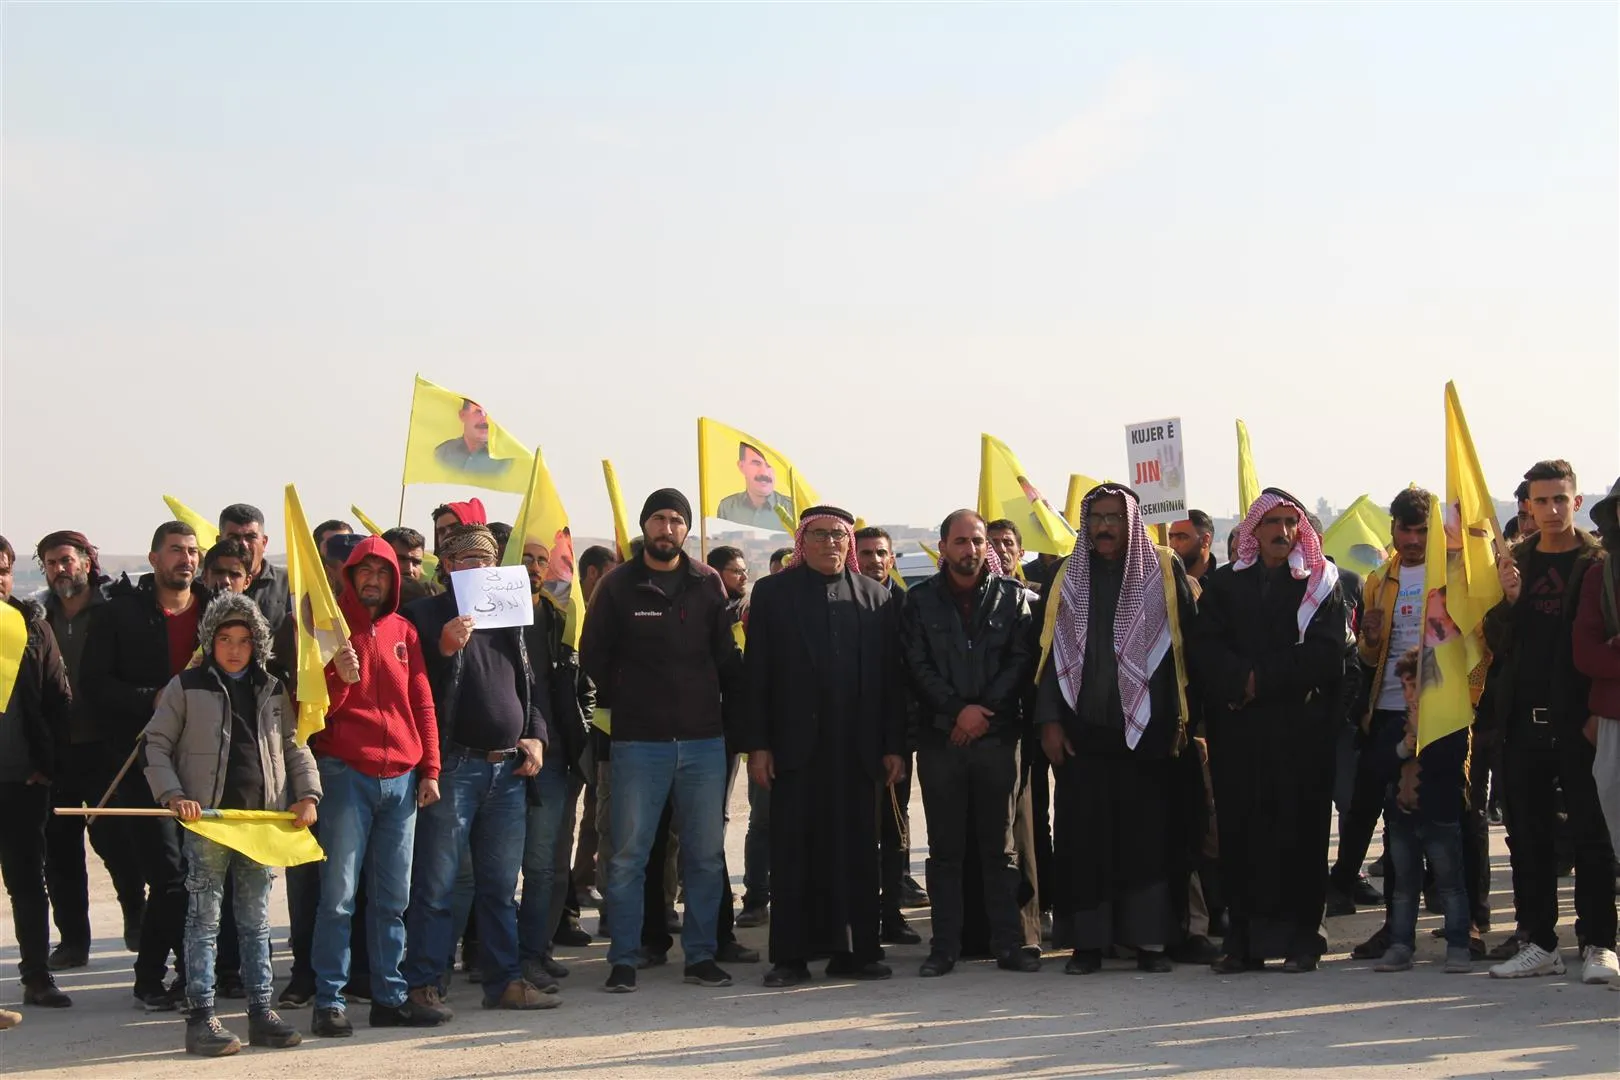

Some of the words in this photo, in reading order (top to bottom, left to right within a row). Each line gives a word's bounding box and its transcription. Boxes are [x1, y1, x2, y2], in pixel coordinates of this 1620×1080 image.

[1131, 426, 1164, 444] KUJER
[1135, 459, 1161, 485] JIN
[485, 569, 502, 581] لا
